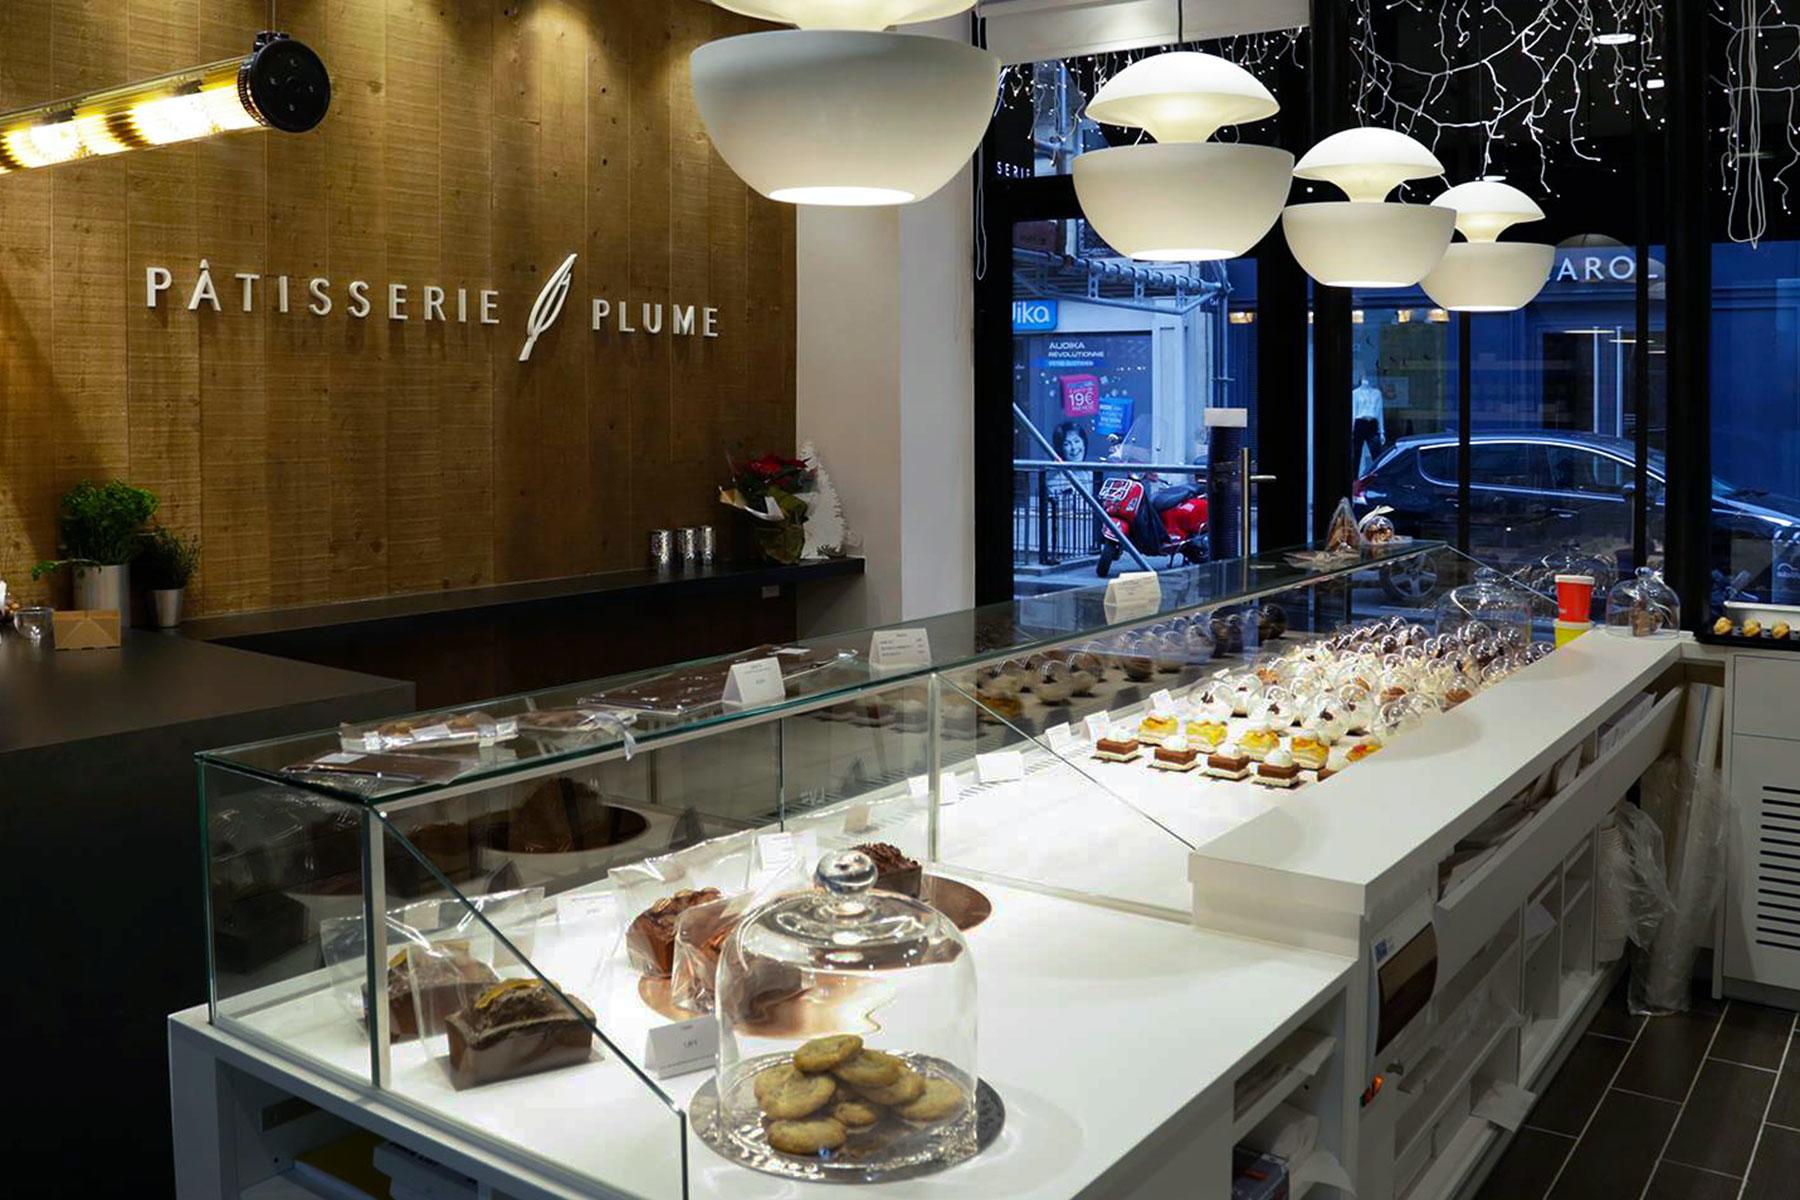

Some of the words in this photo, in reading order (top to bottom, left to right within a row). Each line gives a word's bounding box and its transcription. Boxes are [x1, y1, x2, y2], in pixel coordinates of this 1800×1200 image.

[1546, 255, 1658, 281] ARO
[145, 259, 500, 325] PÂTISSERIE
[592, 299, 719, 338] PLUME
